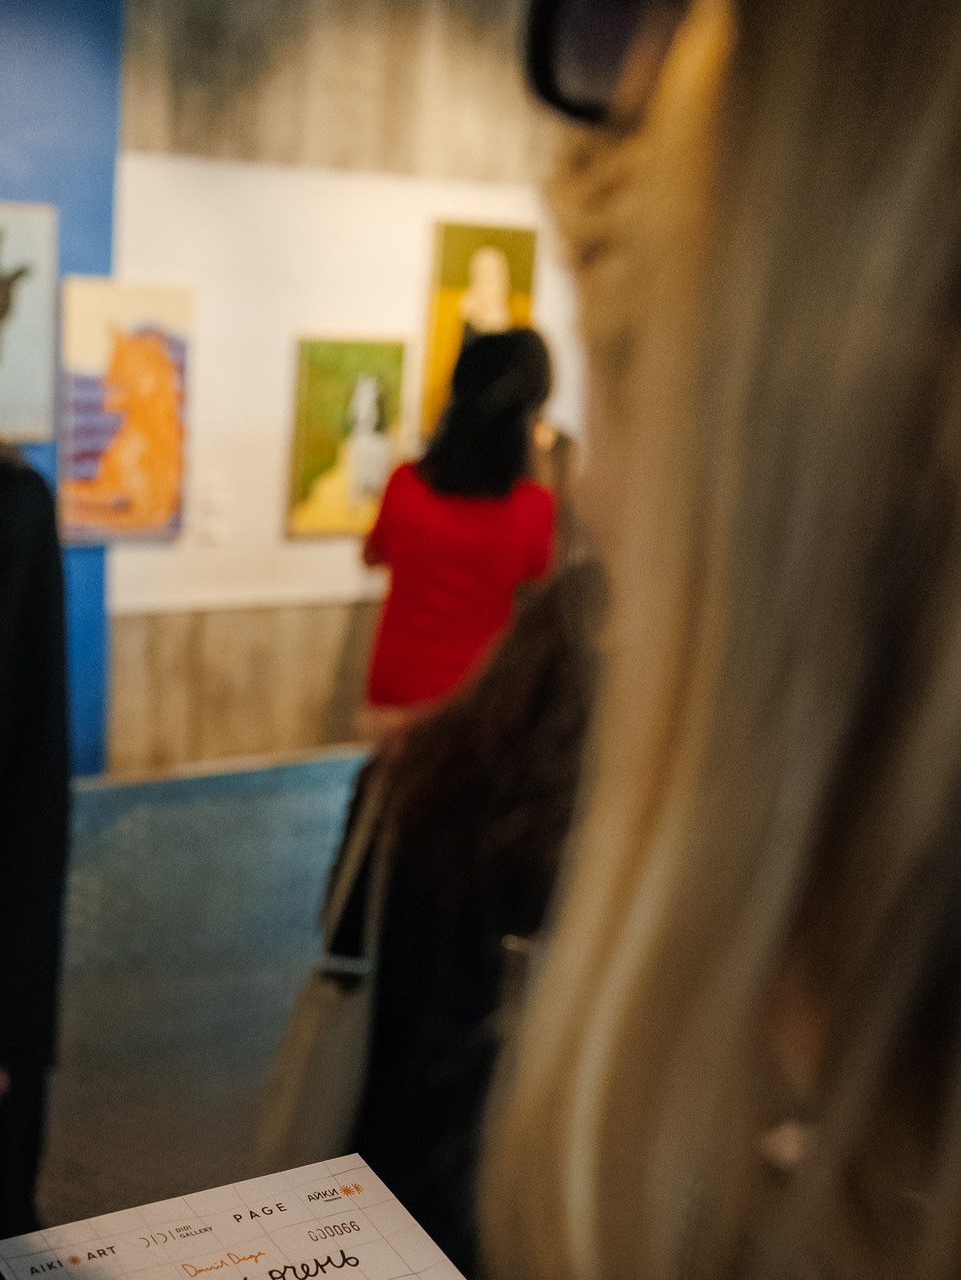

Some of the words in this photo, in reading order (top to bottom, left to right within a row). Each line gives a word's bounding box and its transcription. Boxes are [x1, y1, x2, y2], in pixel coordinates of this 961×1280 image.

[307, 1188, 339, 1202] АЙКИ
[233, 1202, 288, 1223] PAGE
[175, 1225, 192, 1233] DIDI
[180, 1226, 214, 1239] GALLERY
[308, 1220, 361, 1242] 000066
[30, 1259, 64, 1275] AIKI
[87, 1246, 117, 1261] ART
